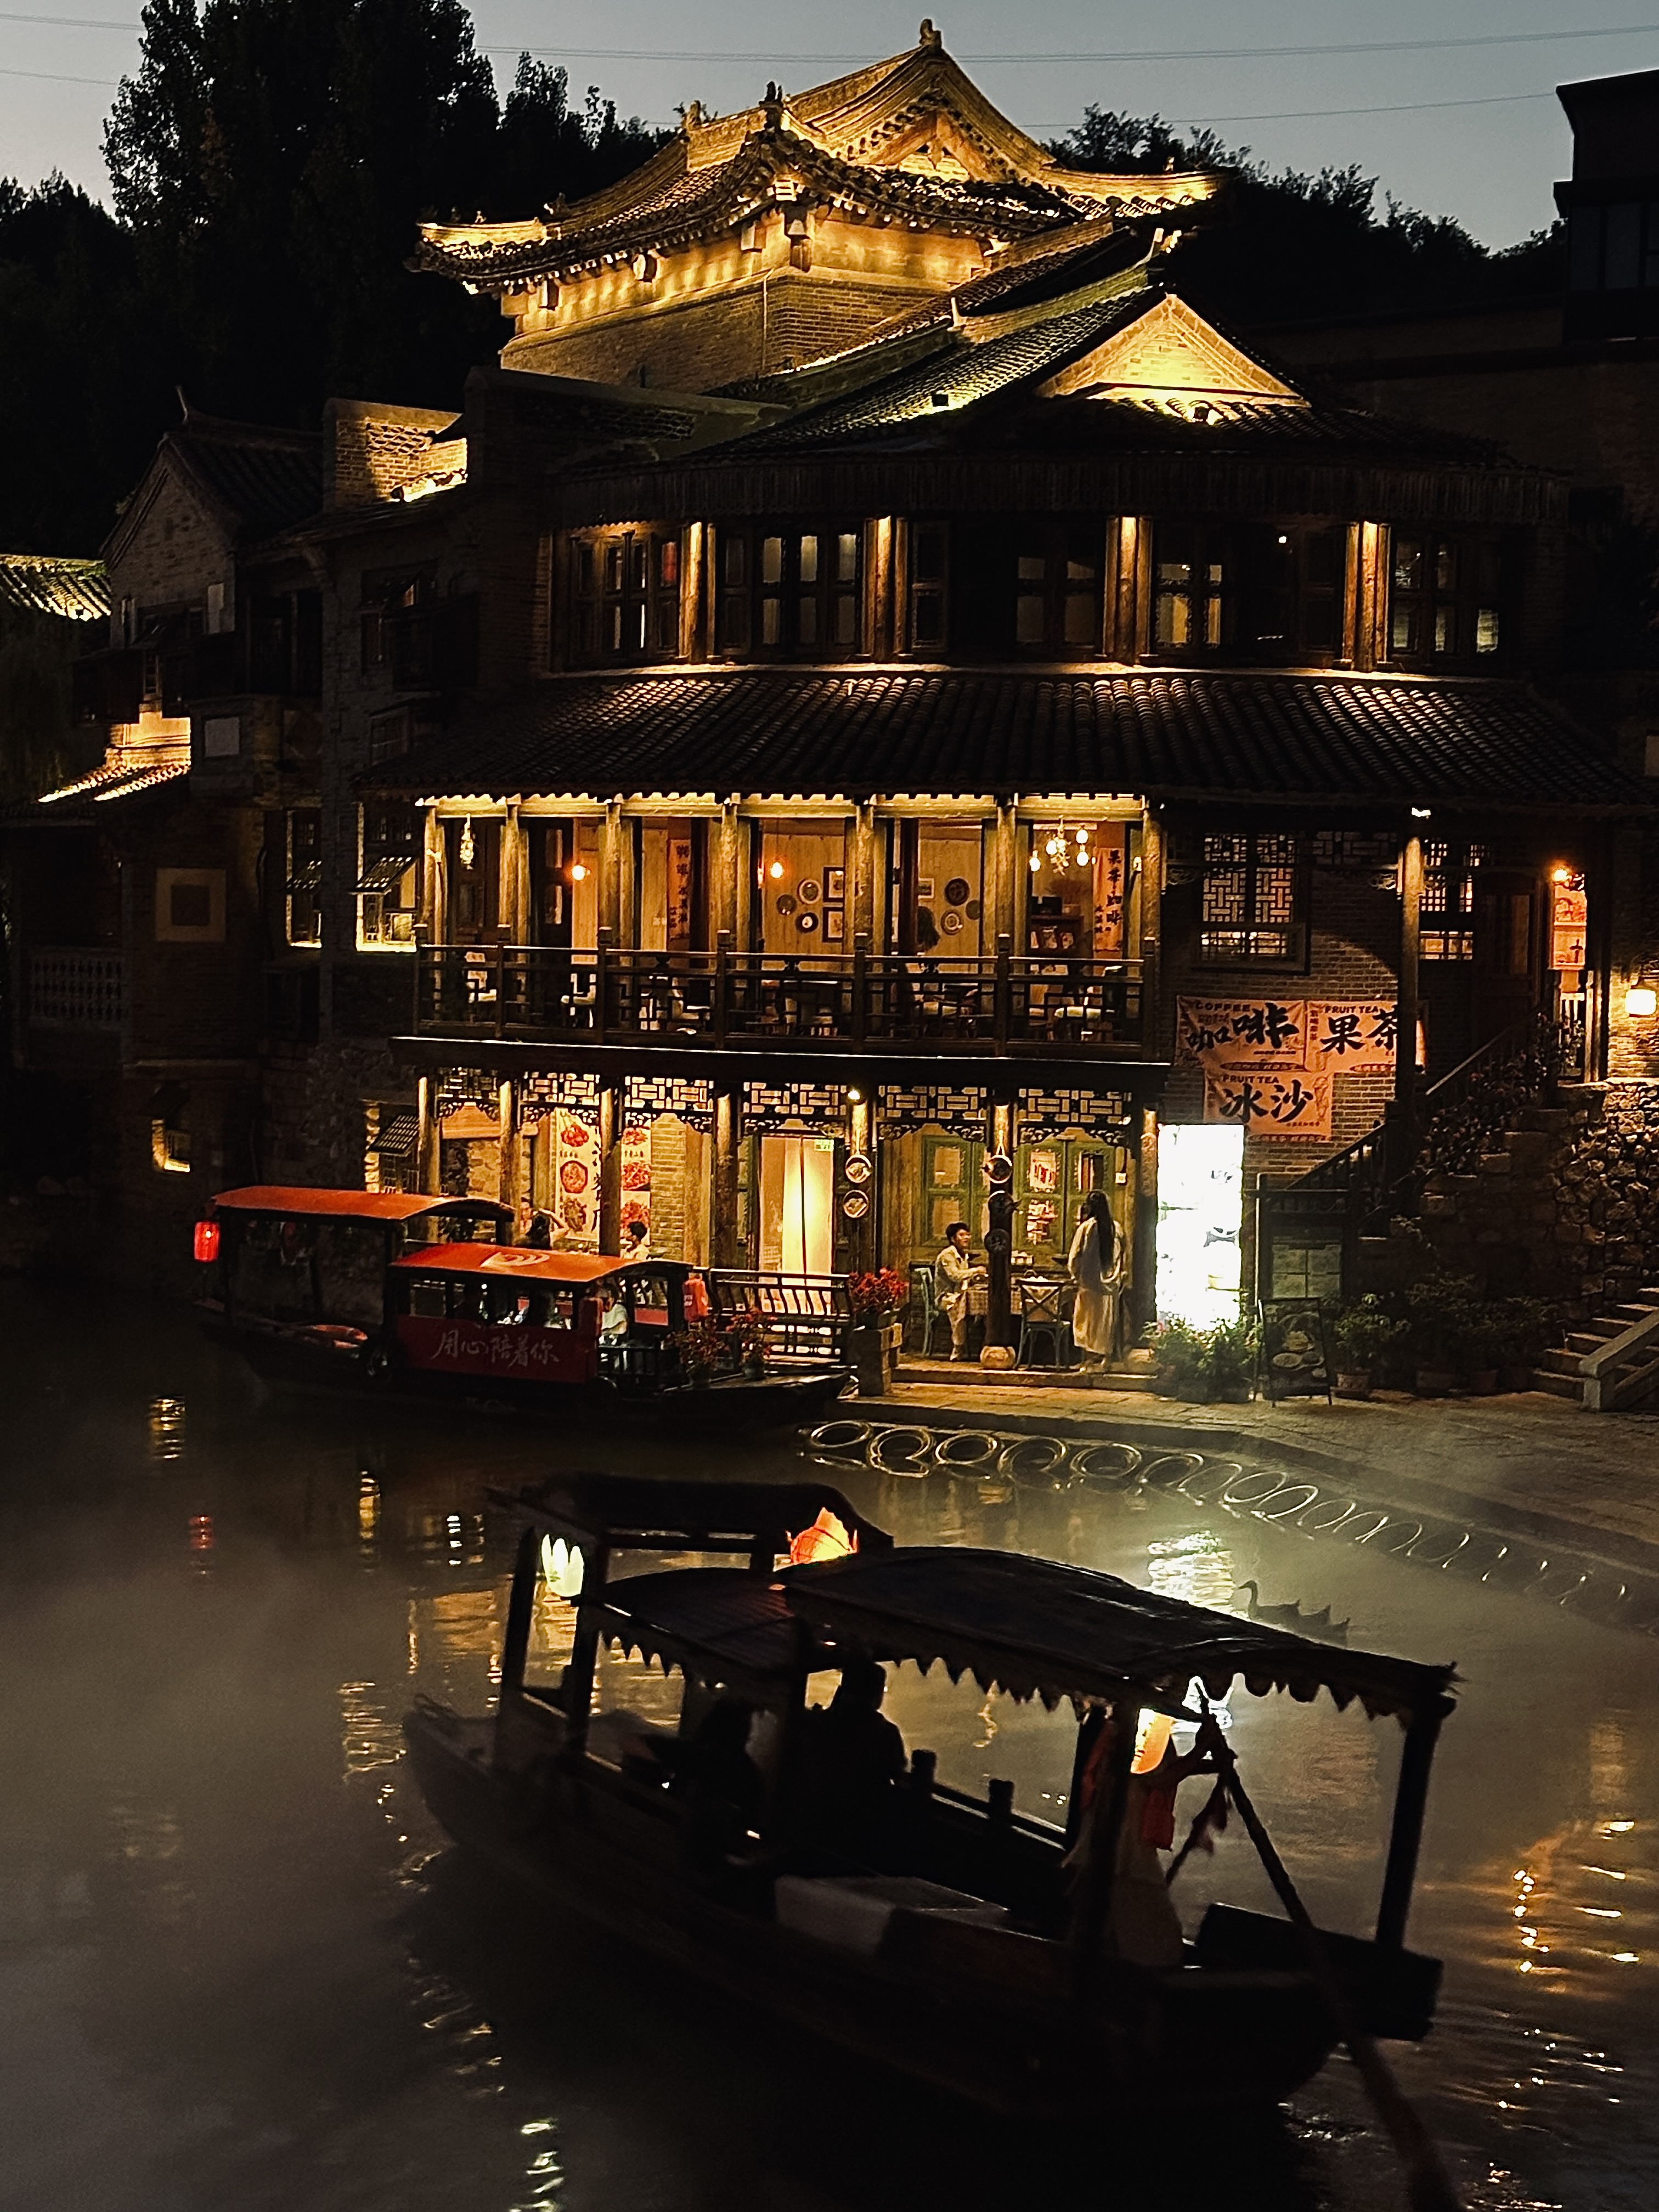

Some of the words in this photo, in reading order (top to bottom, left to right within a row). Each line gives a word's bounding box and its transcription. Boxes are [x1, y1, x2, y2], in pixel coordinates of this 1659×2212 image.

[1195, 1000, 1251, 1012] COFFEE
[1185, 1002, 1300, 1052] 咖啡
[1320, 1005, 1398, 1055] 果茶
[1222, 1075, 1255, 1083] FRUIT
[1219, 1079, 1313, 1124] 冰沙
[431, 1330, 560, 1367] 用心陪着你
